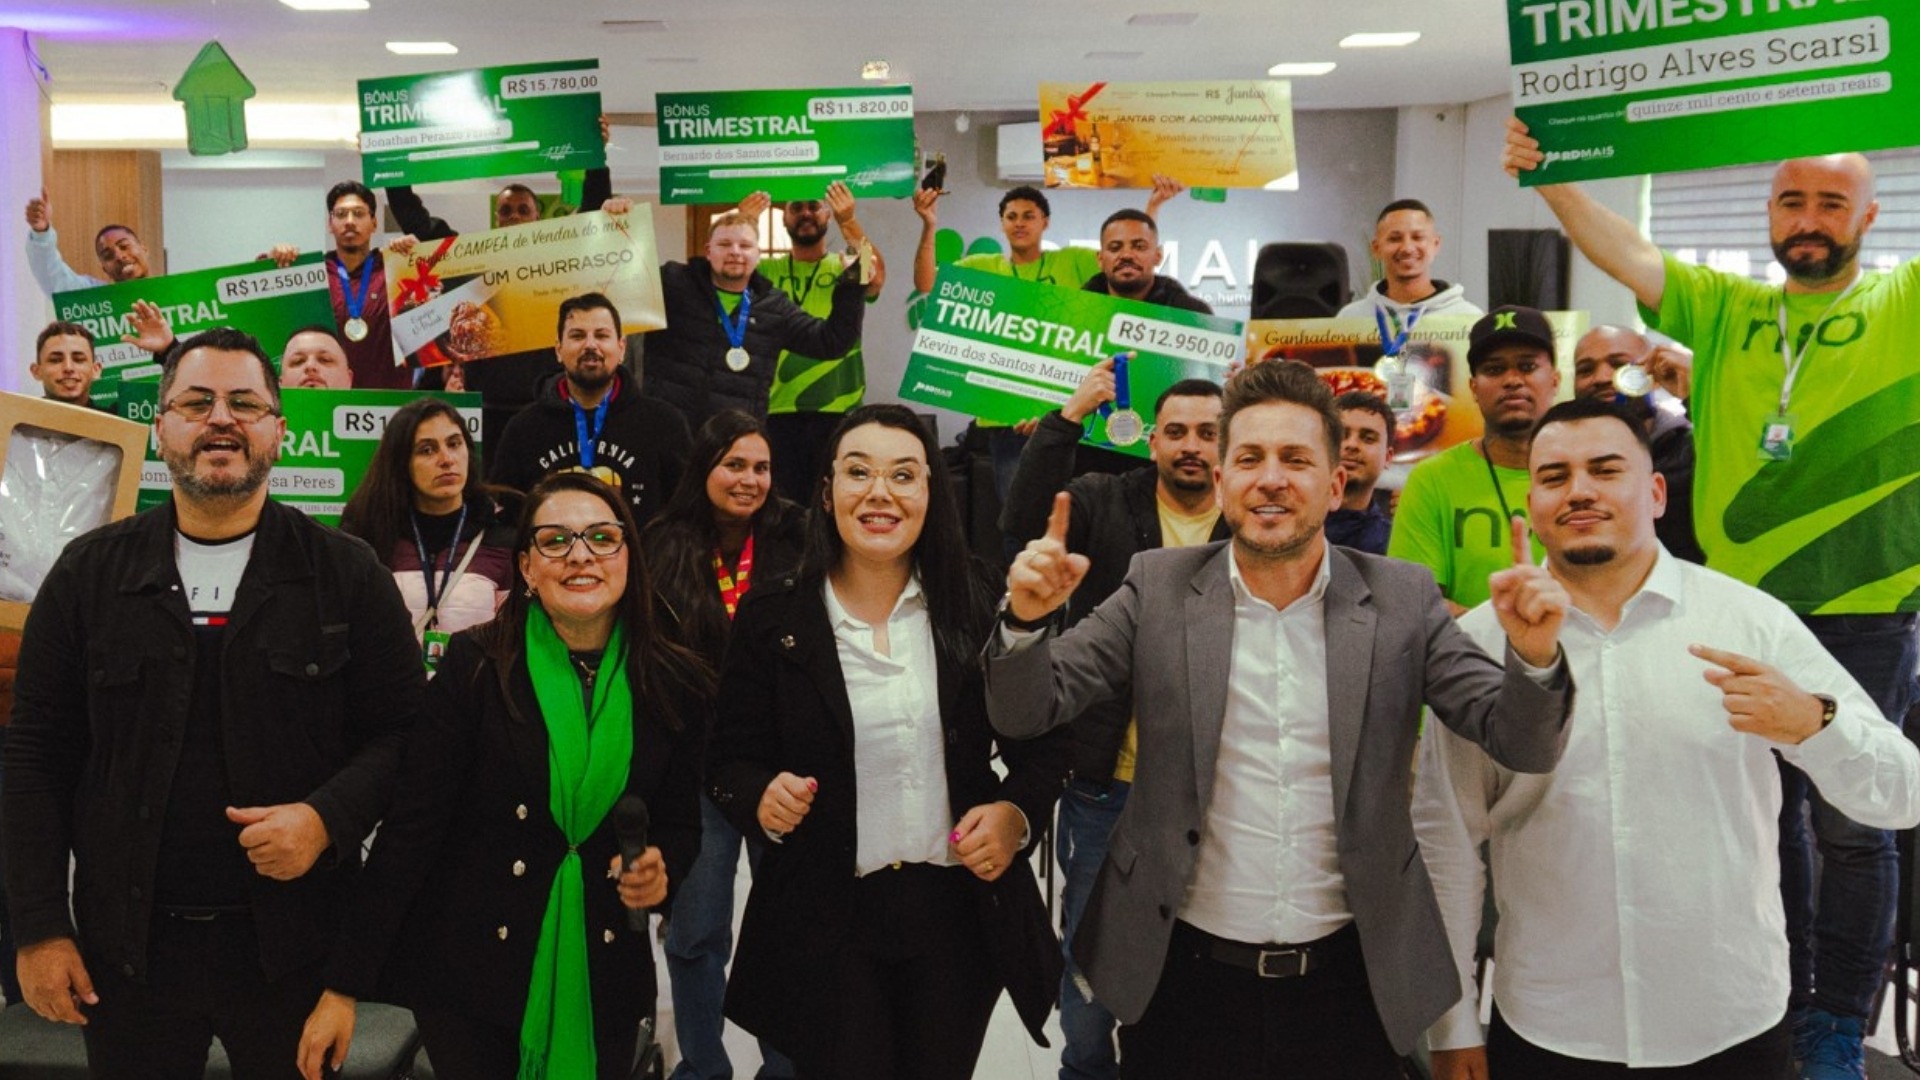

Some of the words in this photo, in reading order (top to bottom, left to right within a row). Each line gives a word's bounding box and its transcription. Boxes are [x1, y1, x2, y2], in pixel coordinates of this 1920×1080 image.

[1522, 0, 1869, 45] TRIMES
[1520, 58, 1647, 97] Rodrigo
[1659, 47, 1756, 79] Alves
[1767, 23, 1880, 66] Scarsi
[363, 89, 408, 105] BÔNUS
[507, 75, 598, 94] R$15.780,00
[1632, 100, 1683, 118] quinze
[1687, 94, 1713, 110] mil
[1717, 89, 1761, 105] cento
[1765, 88, 1774, 100] e
[1778, 81, 1836, 99] setenta
[1840, 75, 1885, 92] reais.
[364, 95, 507, 125] TRIMAL
[663, 104, 710, 118] BÔNUS
[814, 100, 909, 115] R$11.820,00
[1092, 115, 1109, 123] UM
[1114, 115, 1156, 123] JANTAR
[1160, 115, 1185, 123] COM
[1190, 114, 1280, 123] ACOMPANHANTE
[663, 115, 815, 139] TRIMESTRAL
[365, 135, 418, 149] Jonathan
[663, 147, 712, 161] Bernardo
[715, 147, 733, 160] dos
[736, 146, 772, 159] Santos
[775, 144, 815, 158] Goulart
[1562, 146, 1615, 161] RDMAIS
[513, 232, 528, 249] de
[532, 226, 578, 245] Vendas
[582, 221, 597, 236] do
[483, 269, 509, 286] UM
[516, 249, 634, 281] CHURRASCO
[226, 268, 326, 297] R$12.550,00
[940, 281, 994, 307] BÔNUS
[62, 300, 113, 319] BÔNUS
[72, 300, 228, 339] RIMTRAL
[936, 299, 1108, 358] TRIMESTRAL
[1118, 320, 1236, 360] R$12.950,00
[1264, 329, 1362, 345] Ganhadores
[109, 349, 126, 361] da
[918, 335, 958, 356] Kevin
[962, 346, 986, 362] dos
[989, 352, 1035, 373] Santos
[1039, 363, 1085, 384] Martin
[539, 440, 635, 469] CALIRNIA
[293, 475, 336, 489] Peres
